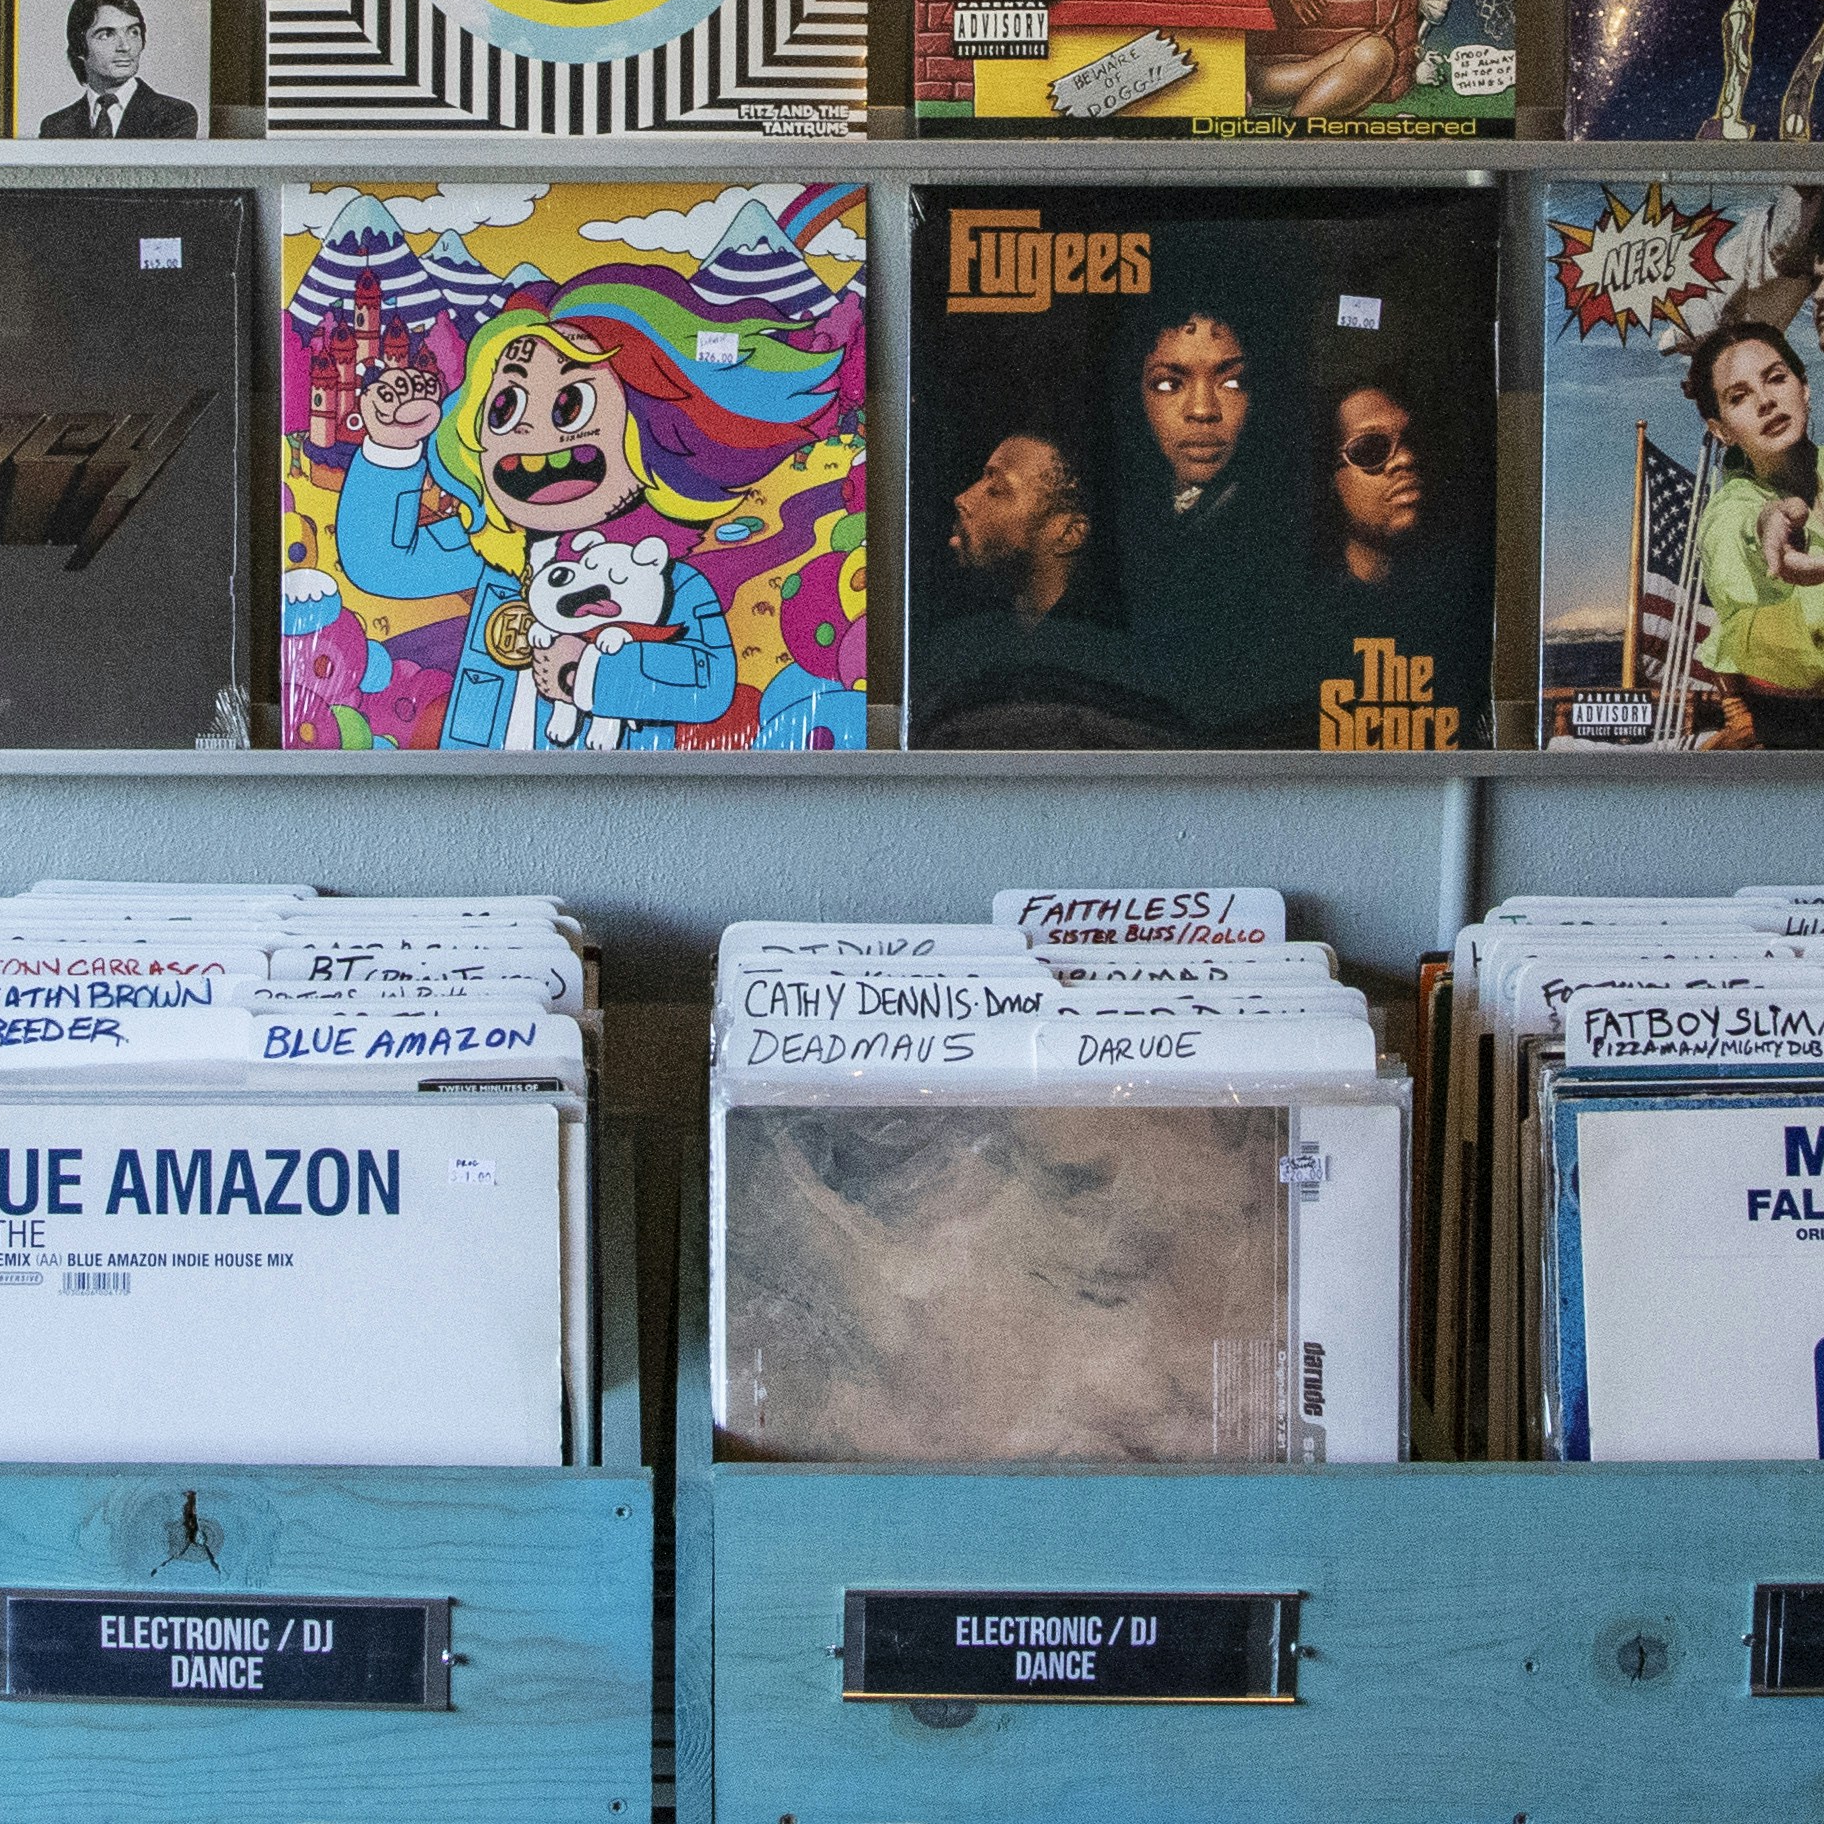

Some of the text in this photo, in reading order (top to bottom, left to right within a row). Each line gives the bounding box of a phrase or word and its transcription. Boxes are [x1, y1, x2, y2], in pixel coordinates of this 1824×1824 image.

[958, 13, 1045, 39] ADVISORY
[738, 103, 850, 120] FITZ AND THE
[762, 120, 851, 136] TANTRUMS
[1191, 115, 1477, 138] Digitally Remastered
[947, 208, 1152, 314] Fugees
[1601, 227, 1683, 293] NFR!
[1353, 637, 1434, 702] The
[1319, 678, 1460, 752] Score
[1575, 705, 1651, 725] ADVISORY
[744, 980, 972, 1022] CATHY DENNIS
[264, 1023, 537, 1060] BLUE AMAZON
[1077, 1031, 1203, 1067] DARUDE
[105, 1147, 401, 1216] AMAZON
[67, 1253, 104, 1268] BLUE
[107, 1253, 168, 1268] AMAZON
[171, 1253, 210, 1268] INDIE
[214, 1253, 264, 1268] HOUSE
[267, 1253, 295, 1268] MIX
[99, 1615, 334, 1653] ELECTRONIC DJ
[955, 1616, 1157, 1647] ELECTRONIC DJ
[170, 1655, 264, 1690] DANCE
[1015, 1650, 1096, 1681] DANCE
